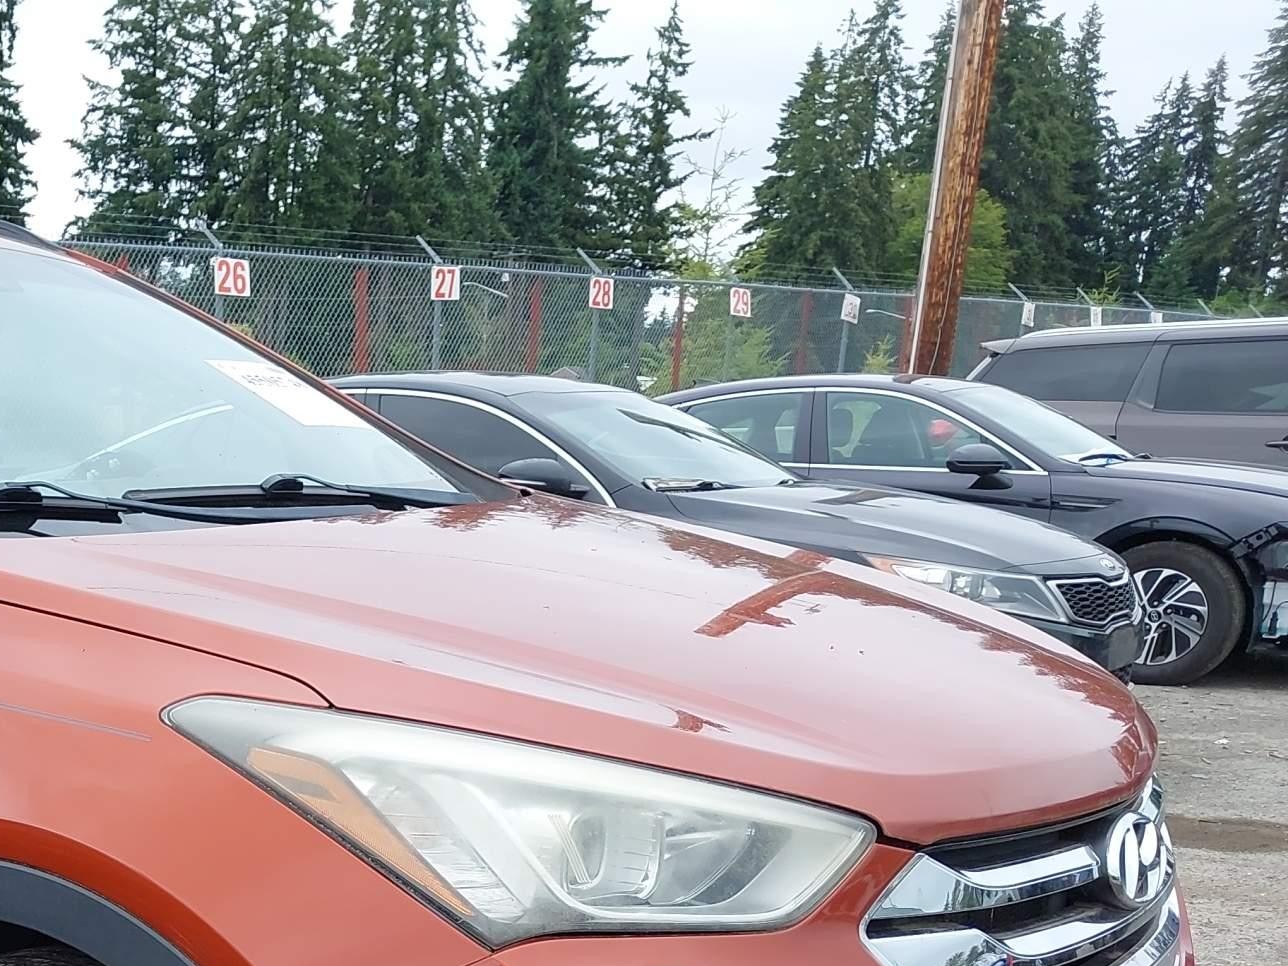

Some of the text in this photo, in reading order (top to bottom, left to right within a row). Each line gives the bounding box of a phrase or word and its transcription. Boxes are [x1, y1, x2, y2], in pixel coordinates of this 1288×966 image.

[216, 259, 247, 295] 26
[434, 269, 458, 300] 27
[592, 278, 613, 308] 28
[731, 288, 750, 316] 29
